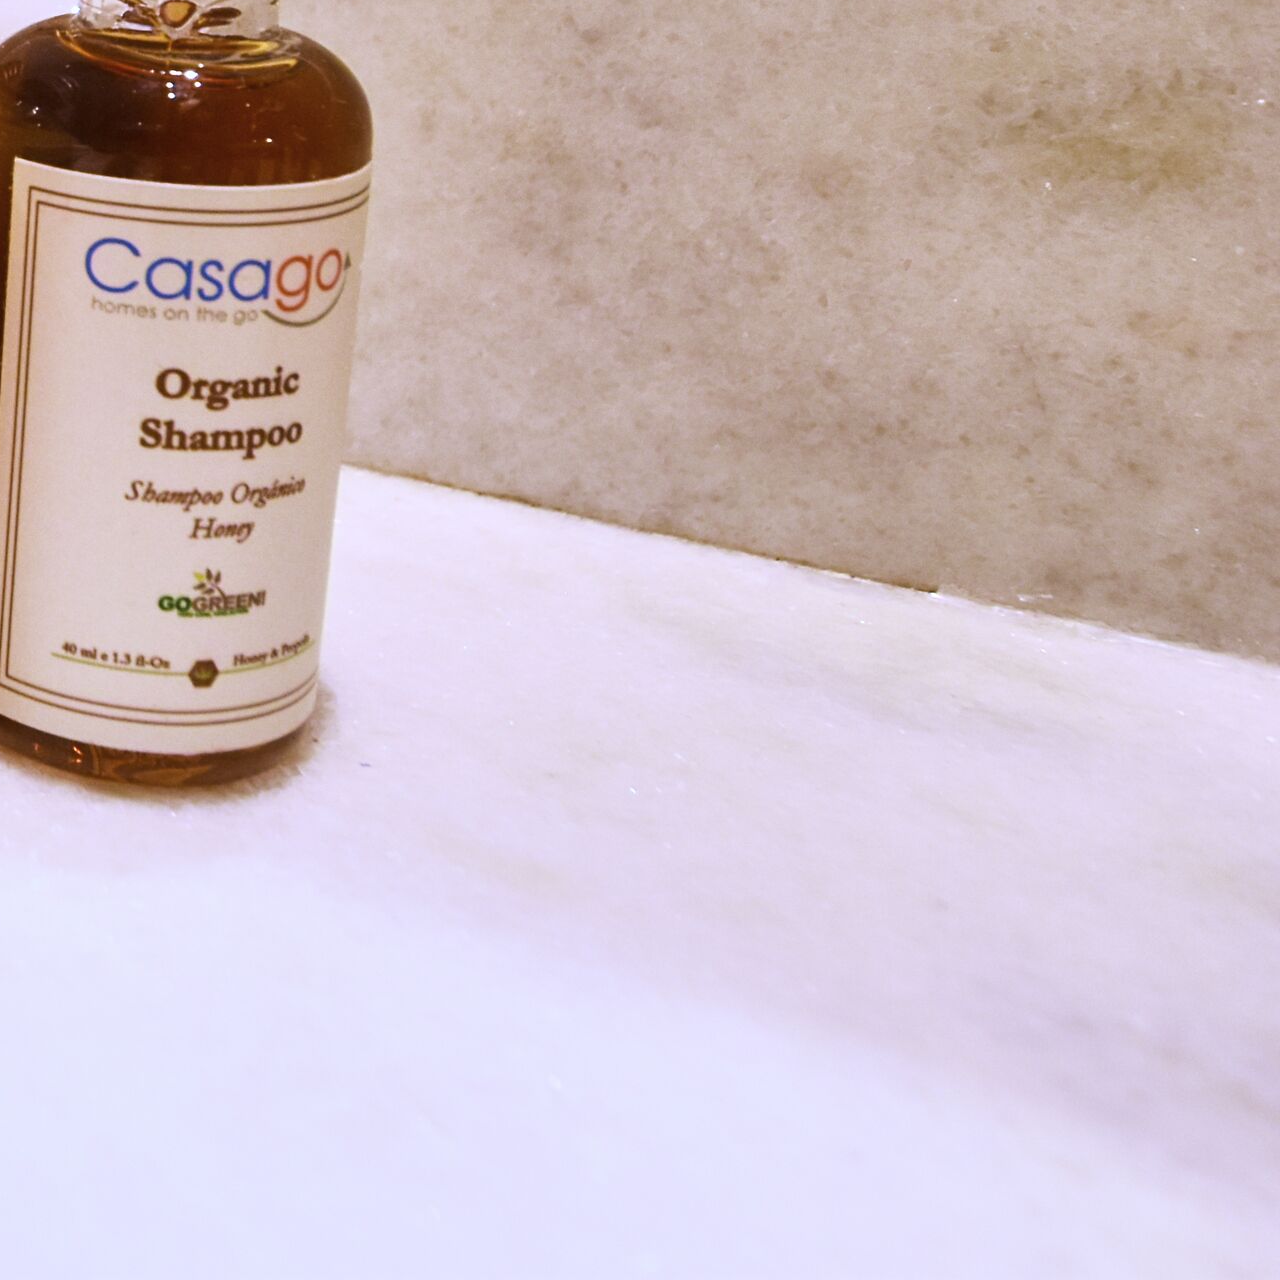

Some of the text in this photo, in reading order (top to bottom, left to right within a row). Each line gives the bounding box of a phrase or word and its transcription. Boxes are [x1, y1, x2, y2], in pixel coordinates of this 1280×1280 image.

[85, 236, 342, 313] Casago
[91, 295, 259, 326] homes on the go
[155, 365, 300, 411] Organic
[139, 417, 303, 460] Shampoo
[124, 476, 306, 513] Shampoo Orgánico
[188, 518, 256, 546] Honey
[61, 641, 78, 655] 40
[80, 646, 97, 660] ml
[112, 652, 132, 666] 1.3
[233, 651, 268, 666] Honey
